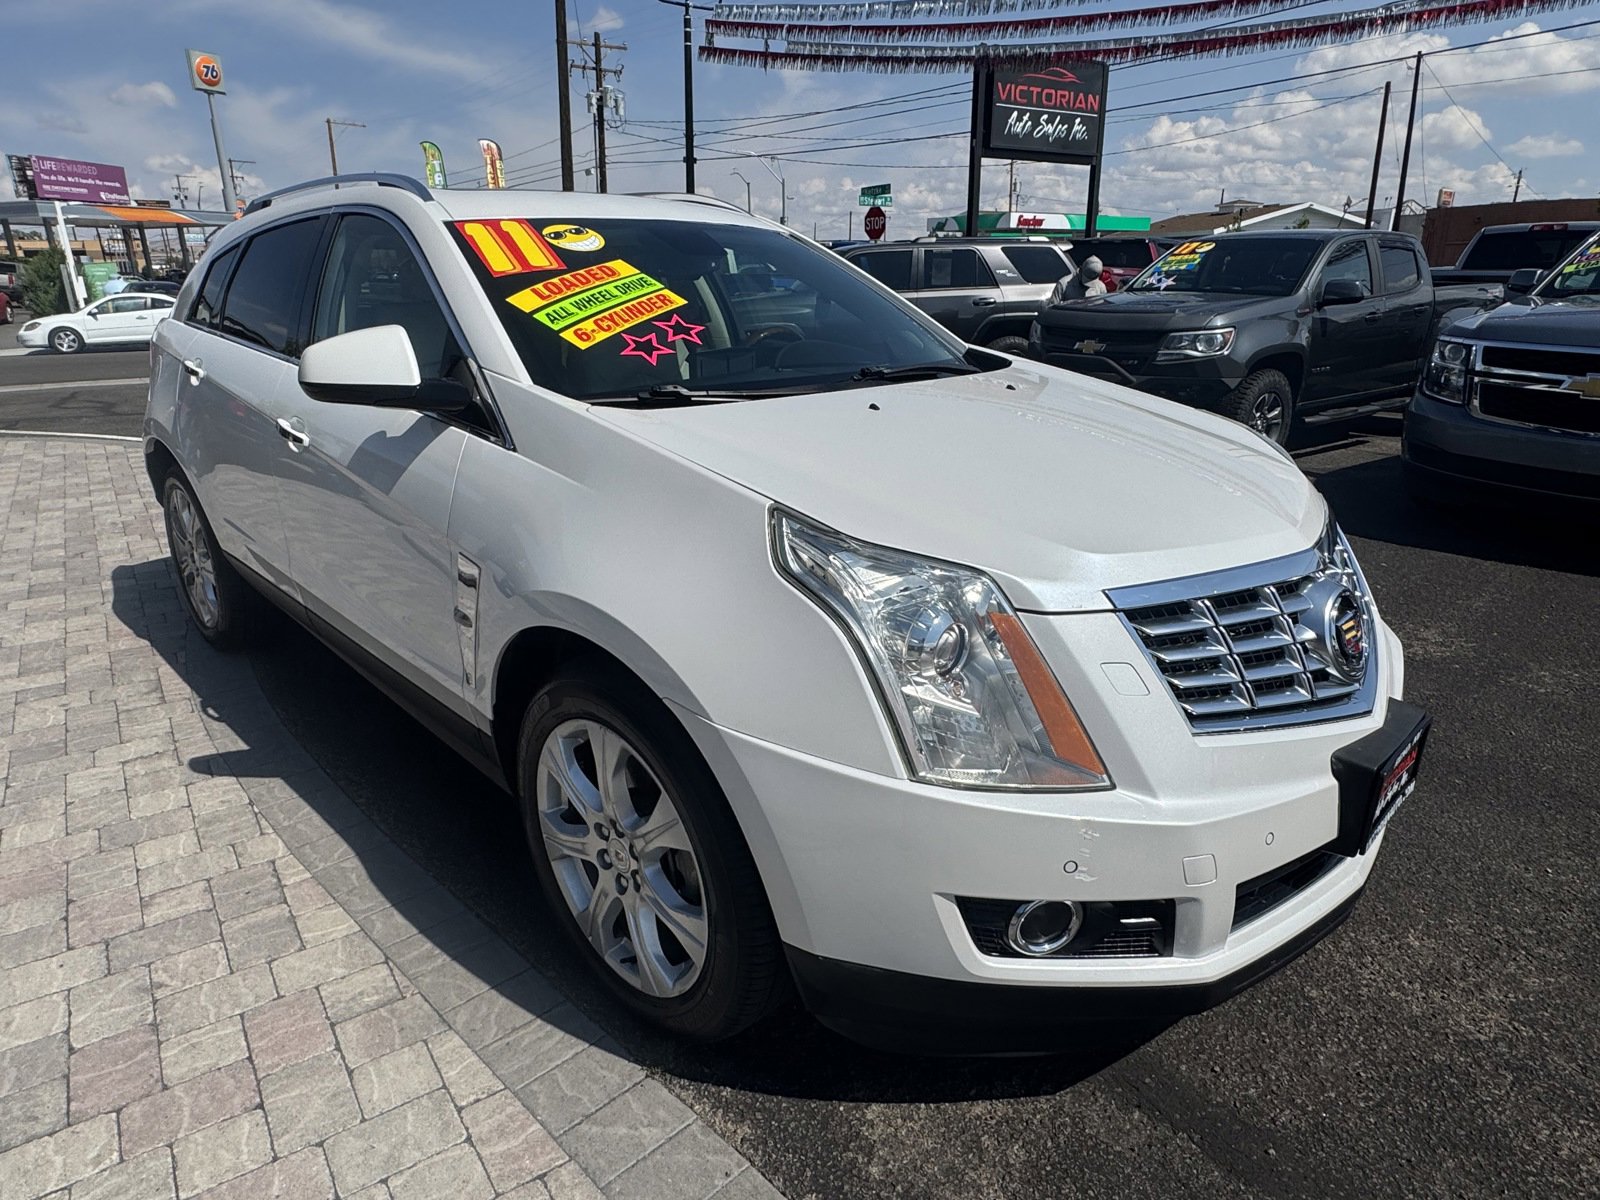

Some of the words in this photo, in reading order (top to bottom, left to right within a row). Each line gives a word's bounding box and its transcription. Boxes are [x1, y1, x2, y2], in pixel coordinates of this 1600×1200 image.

[202, 64, 219, 80] 76
[997, 81, 1100, 112] VICTORIAN
[1004, 110, 1032, 138] Auto
[1033, 114, 1068, 143] Sales
[1069, 117, 1088, 141] Inc.
[866, 216, 885, 231] STOP
[463, 220, 560, 273] 11
[530, 265, 622, 301] LOADED
[544, 308, 575, 326] ALL
[575, 291, 616, 312] WHEEL
[618, 276, 653, 295] DRIVE
[572, 293, 677, 344] 6-CYLINDER
